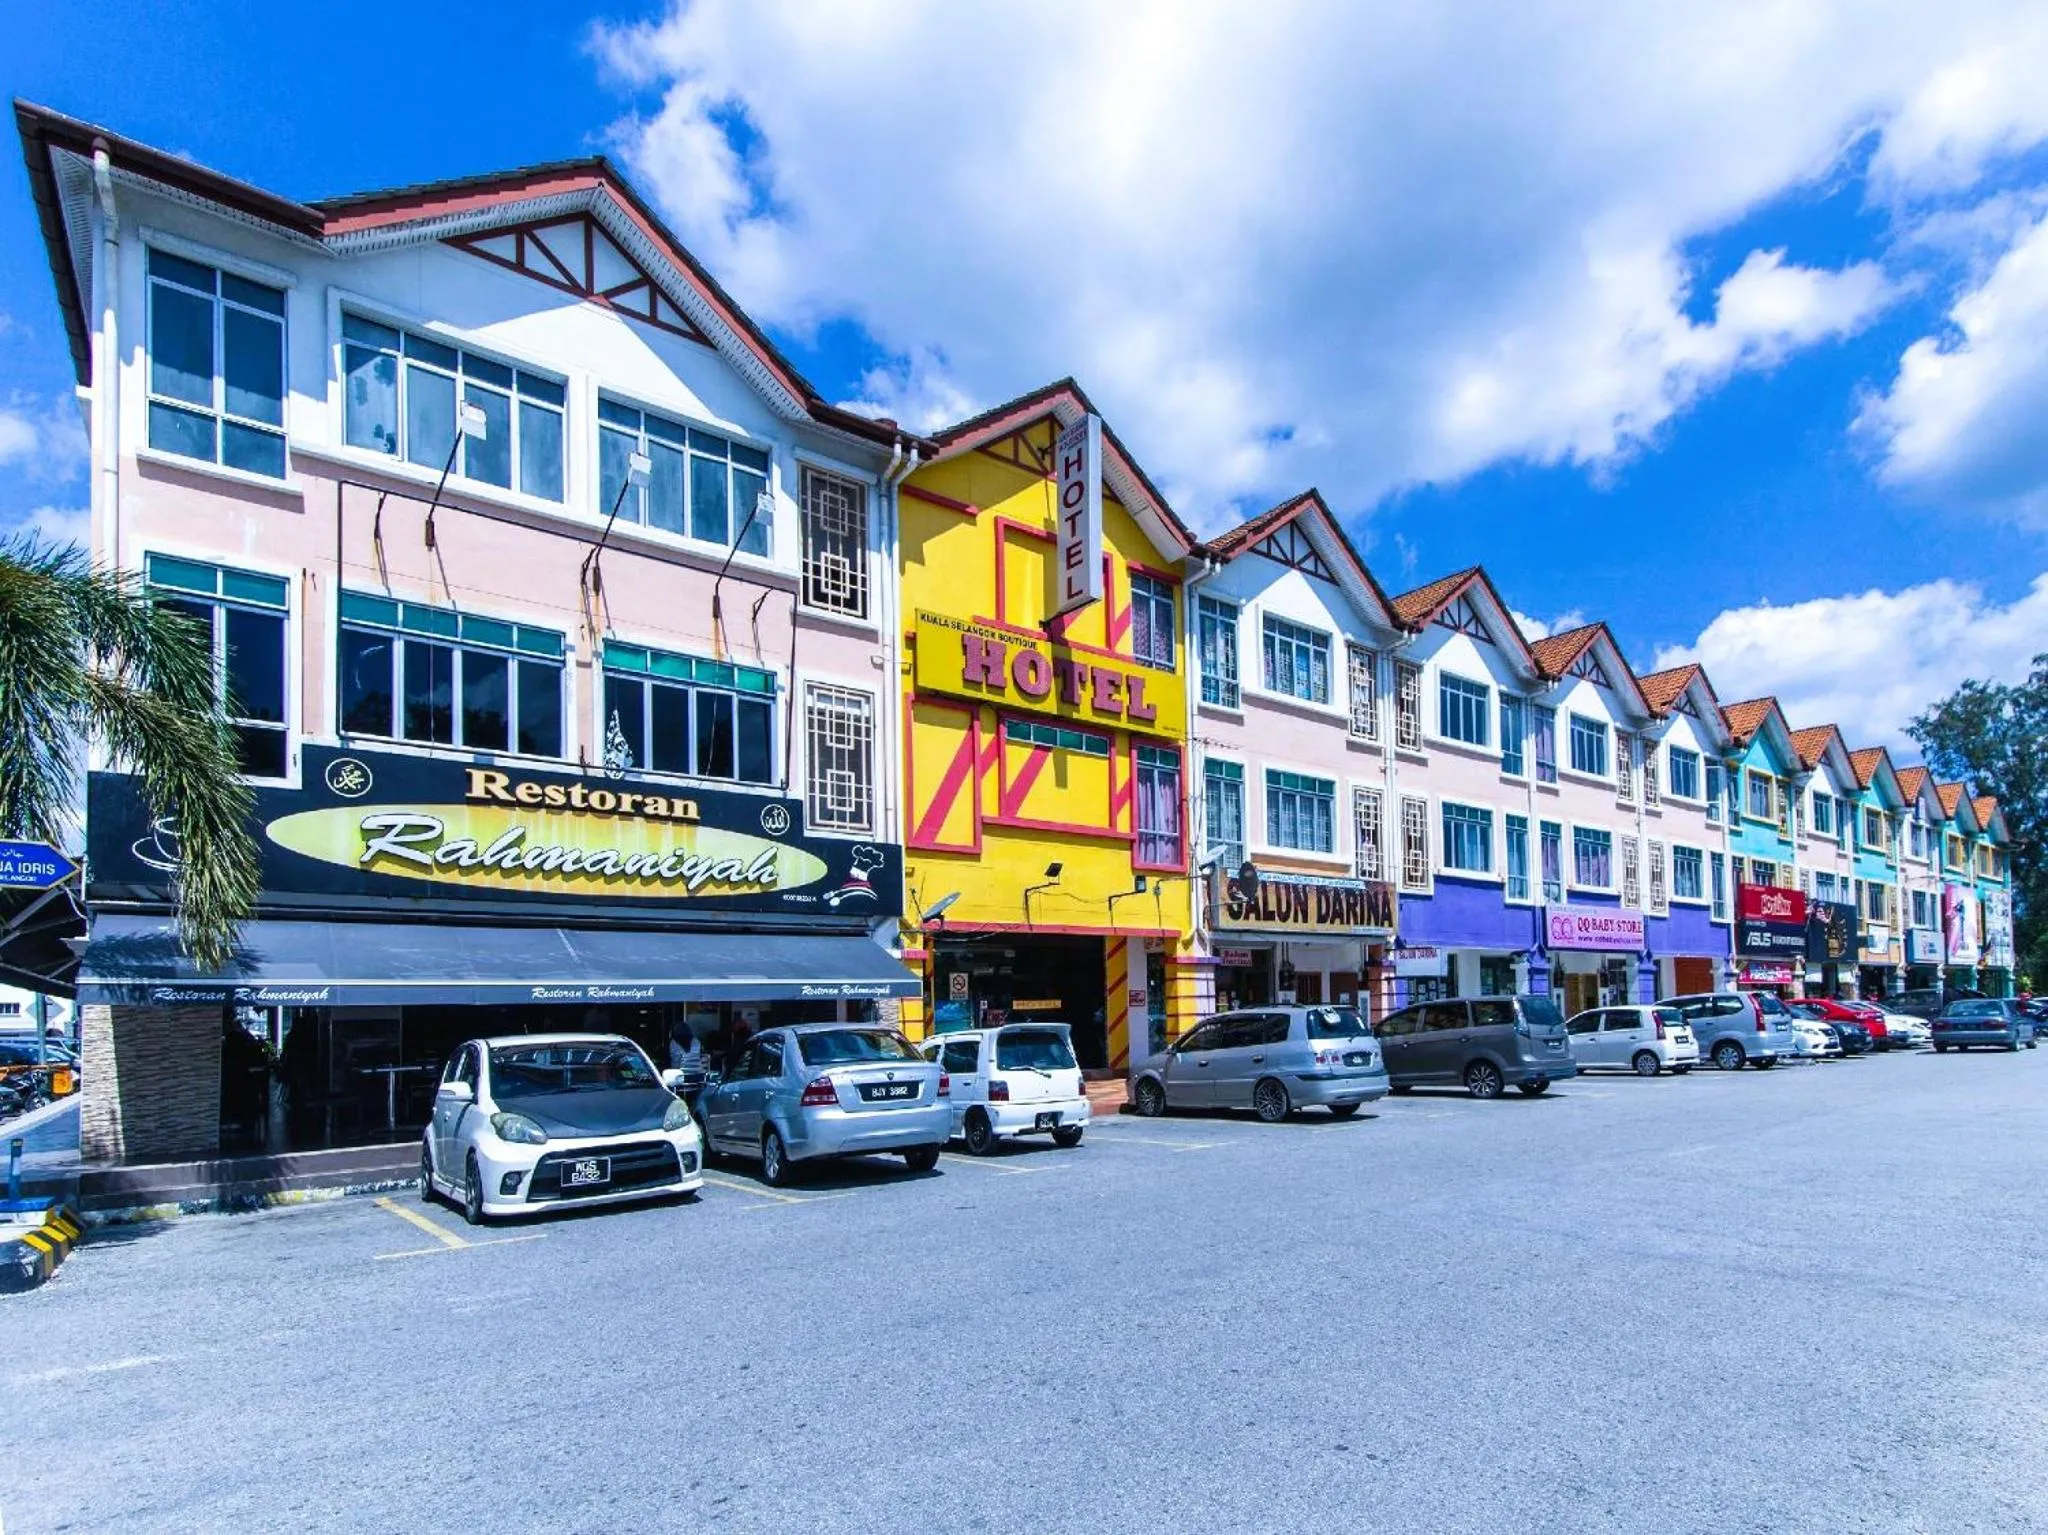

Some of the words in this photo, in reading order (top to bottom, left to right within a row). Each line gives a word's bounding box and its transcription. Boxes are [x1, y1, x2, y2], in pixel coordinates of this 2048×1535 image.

[1063, 447, 1084, 601] HOTEL
[920, 612, 950, 628] KUALA
[951, 620, 996, 639] SELANGOR
[998, 632, 1038, 650] BOUTIQUE
[962, 633, 1157, 721] HOTEL
[465, 768, 701, 820] Restoran
[359, 812, 781, 894] Rahmaniyah
[18, 861, 57, 876] IDRIS
[1226, 878, 1309, 924] SALUN
[1315, 884, 1394, 929] DARINA
[1577, 917, 1590, 933] QQ
[1591, 918, 1614, 932] BABY
[1616, 919, 1643, 934] STORE
[1746, 931, 1772, 947] ASUS
[152, 986, 227, 1001] Restoran
[232, 986, 330, 1004] Rahmaniyah
[531, 986, 583, 999] Restoran
[587, 985, 655, 999] Rahmaniyah
[801, 984, 838, 996] Restoran
[841, 984, 890, 995] Rahmaniyah
